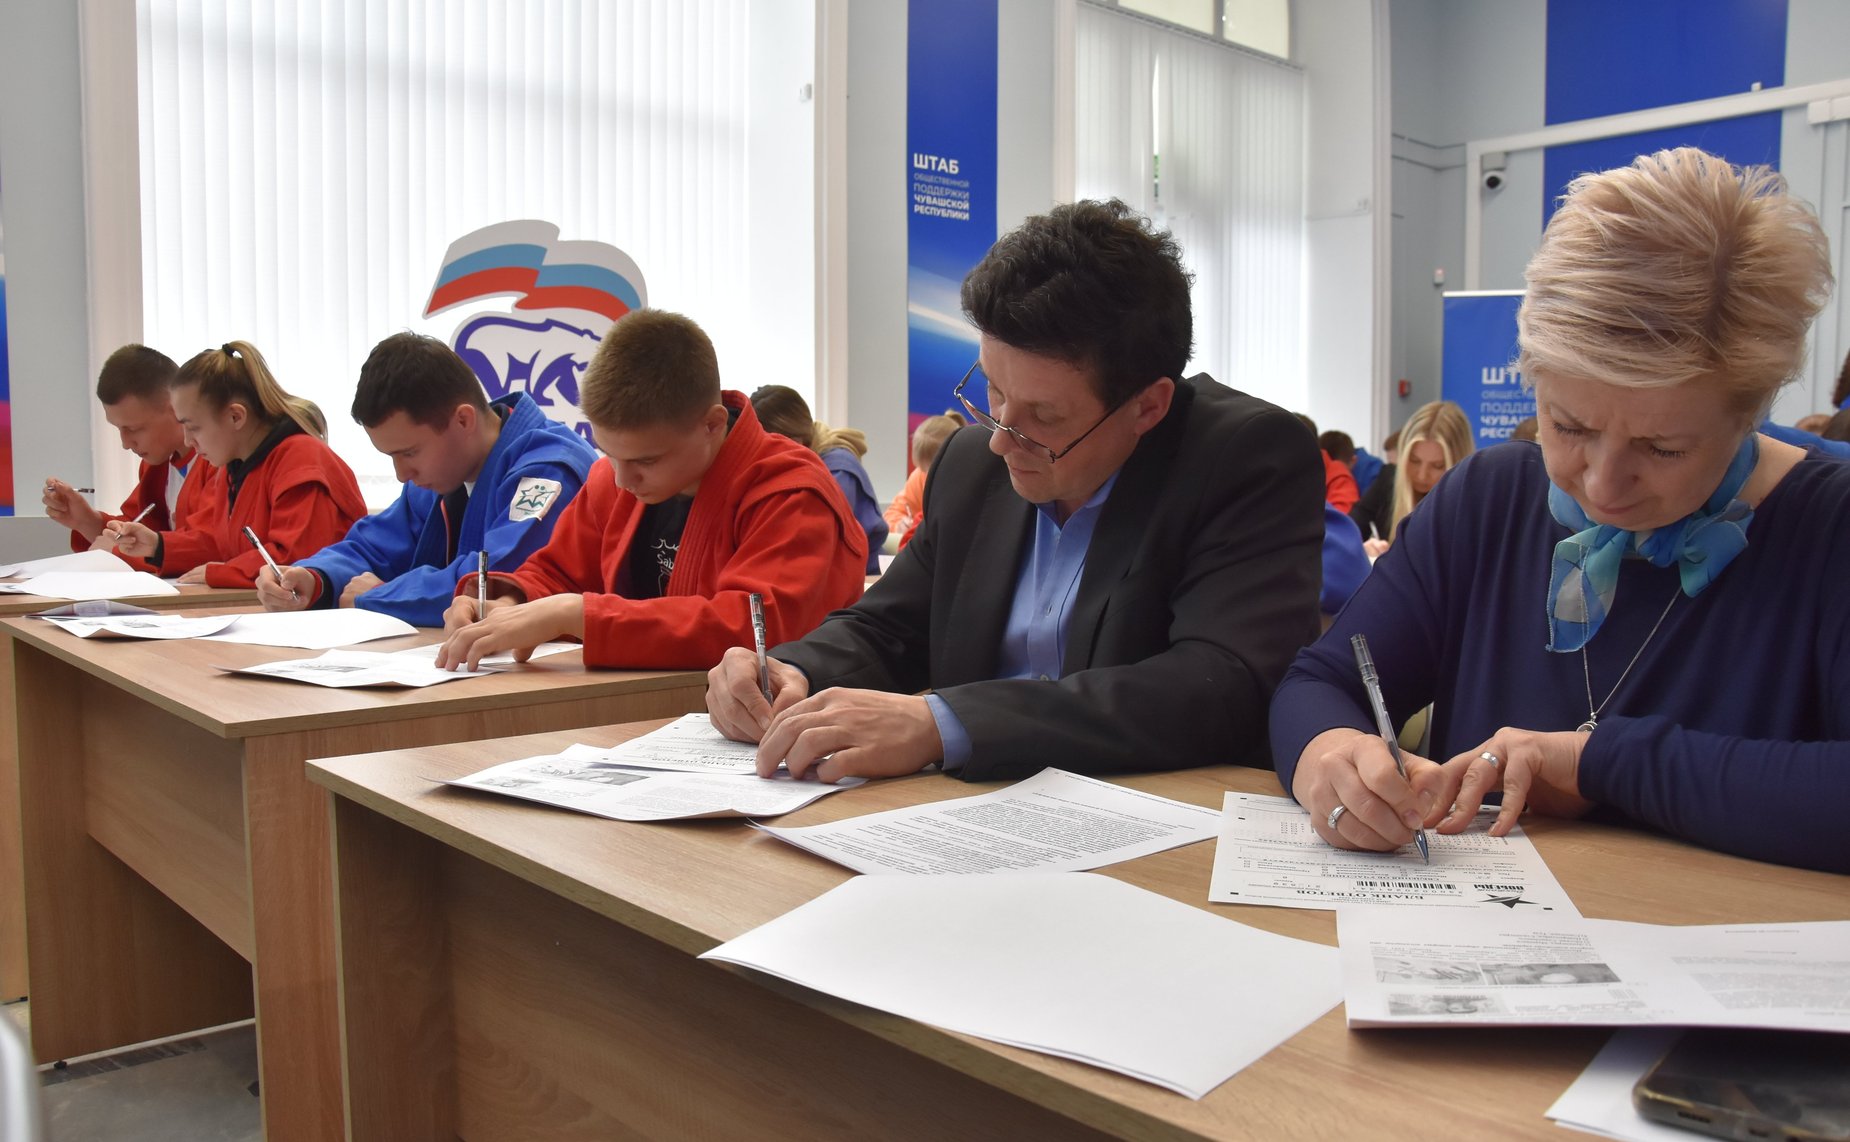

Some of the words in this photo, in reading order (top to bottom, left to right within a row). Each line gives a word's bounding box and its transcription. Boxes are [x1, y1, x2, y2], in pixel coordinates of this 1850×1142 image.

[913, 153, 959, 174] ШТАБ
[914, 183, 969, 199] ПОДДЕРЖКИ
[914, 194, 969, 210] ЧУВАШСКОЙ
[914, 204, 969, 221] РЕСПУБЛИКИ
[1482, 367, 1520, 385] ШТ
